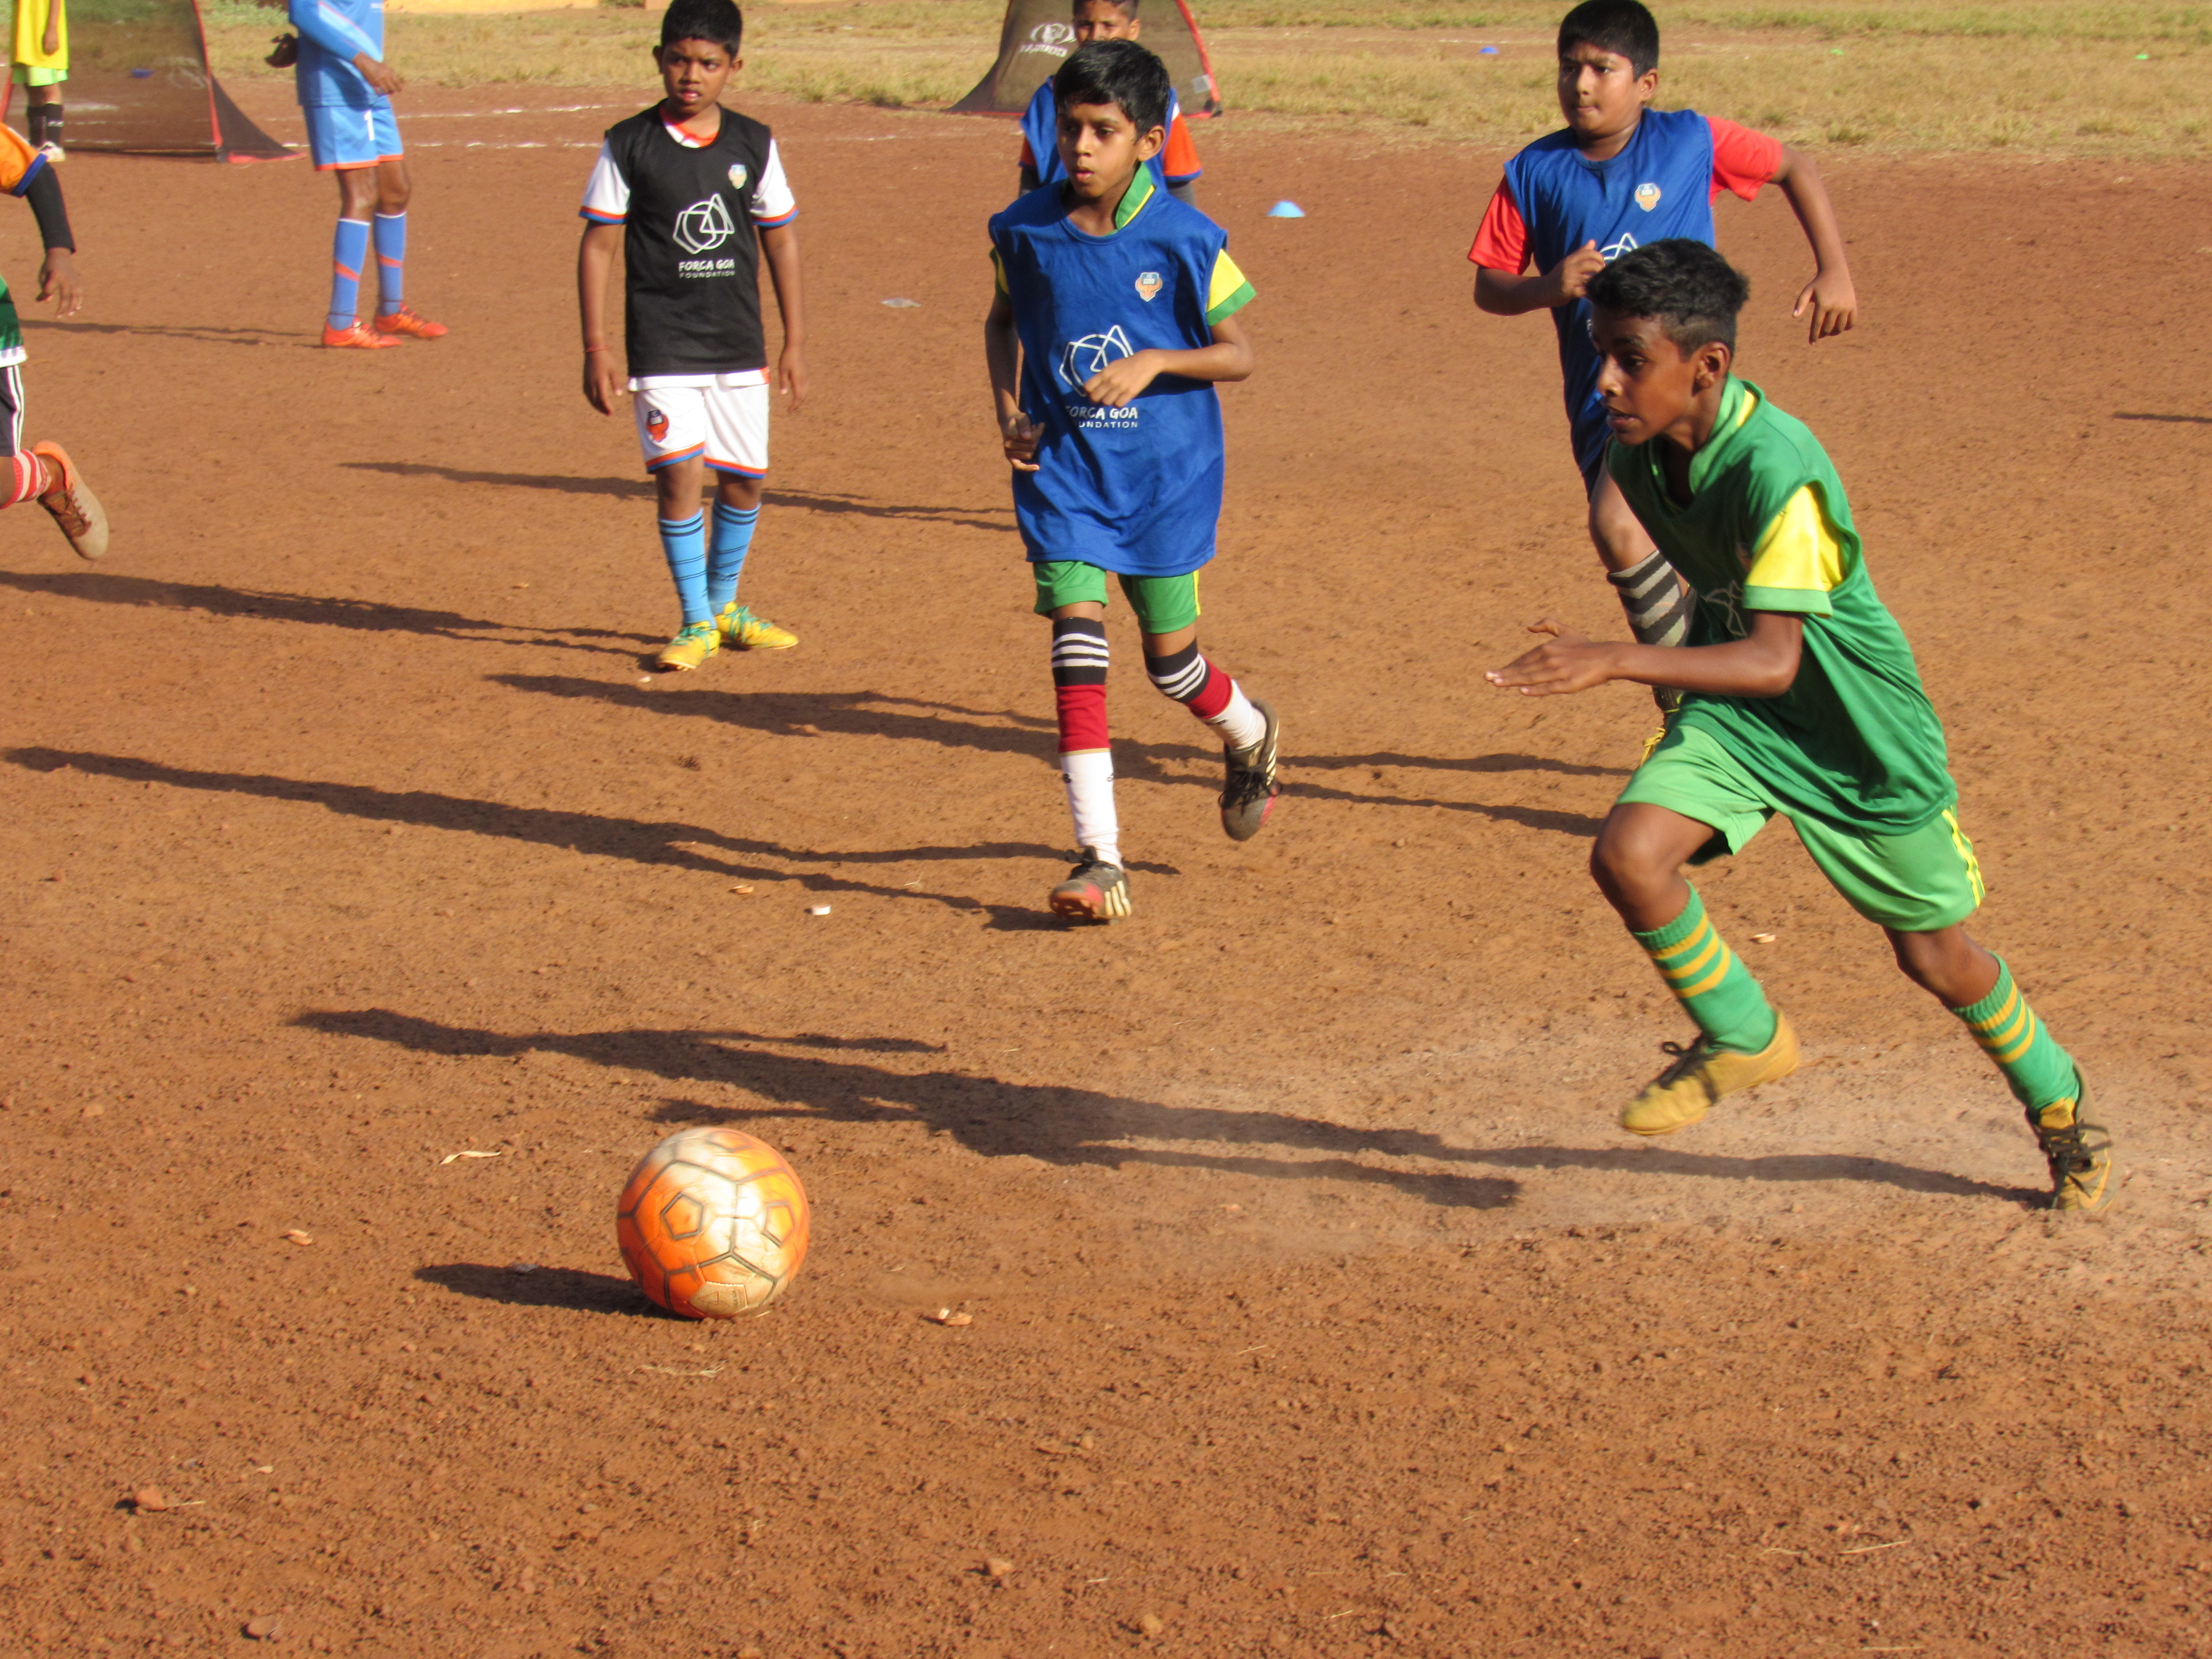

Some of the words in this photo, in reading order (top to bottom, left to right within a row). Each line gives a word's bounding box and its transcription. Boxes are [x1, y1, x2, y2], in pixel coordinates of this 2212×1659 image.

[715, 259, 735, 270] GOA
[679, 270, 735, 278] FOUNDATION
[1109, 407, 1138, 420] GOA
